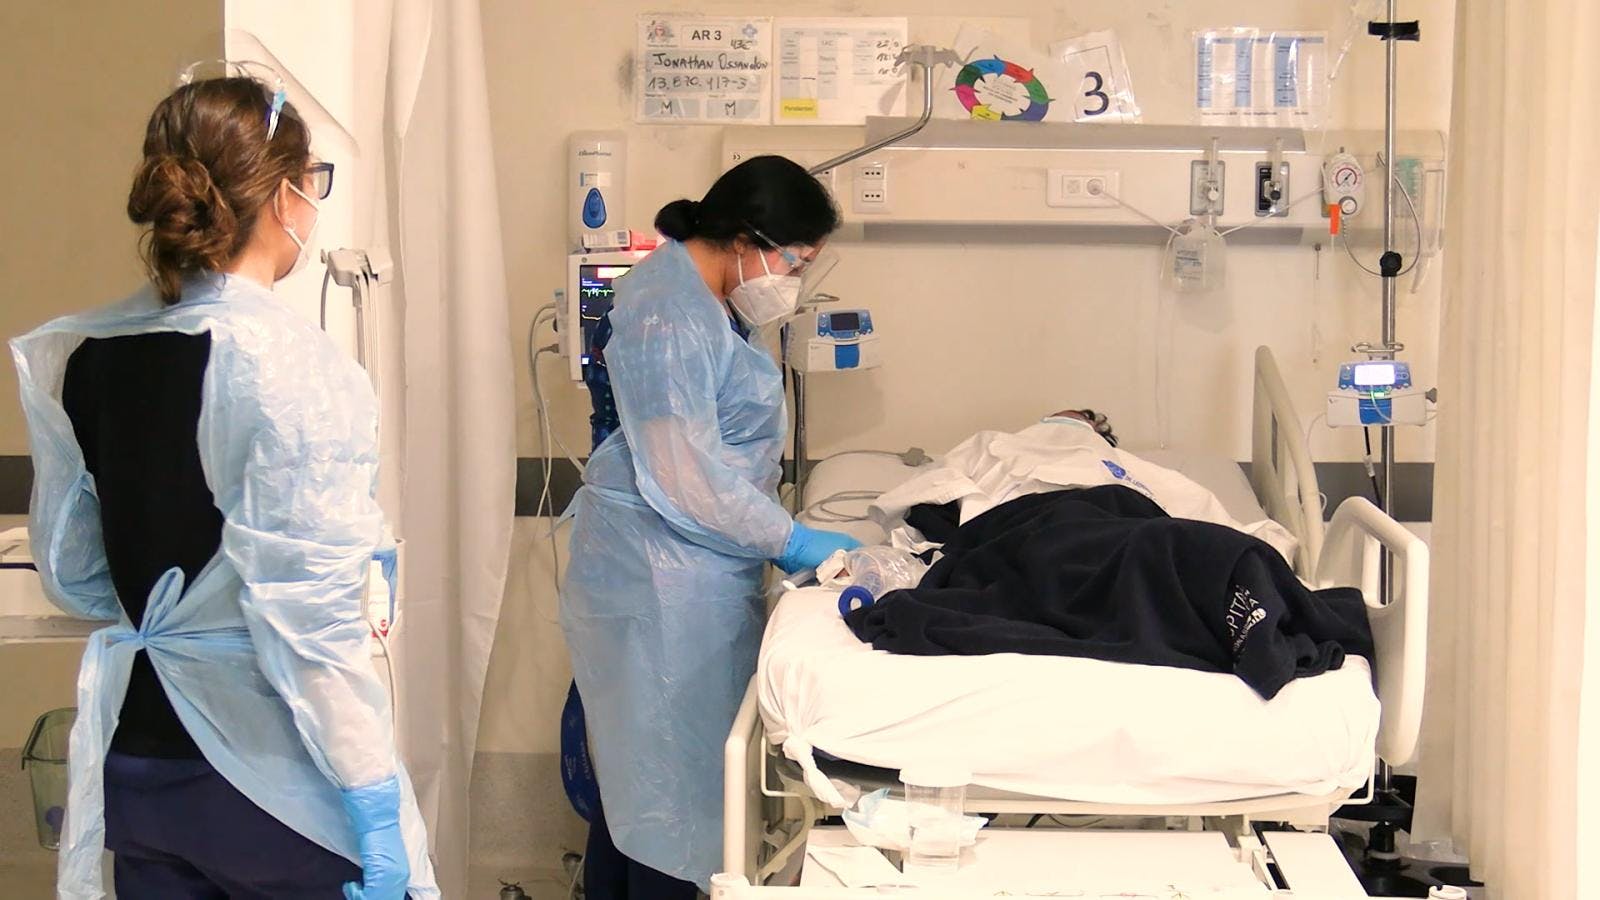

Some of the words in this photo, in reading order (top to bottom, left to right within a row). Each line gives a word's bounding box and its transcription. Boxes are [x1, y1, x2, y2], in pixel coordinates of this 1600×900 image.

[691, 30, 710, 40] AR
[714, 30, 722, 40] 3
[1083, 71, 1109, 116] 3
[724, 100, 736, 115] M
